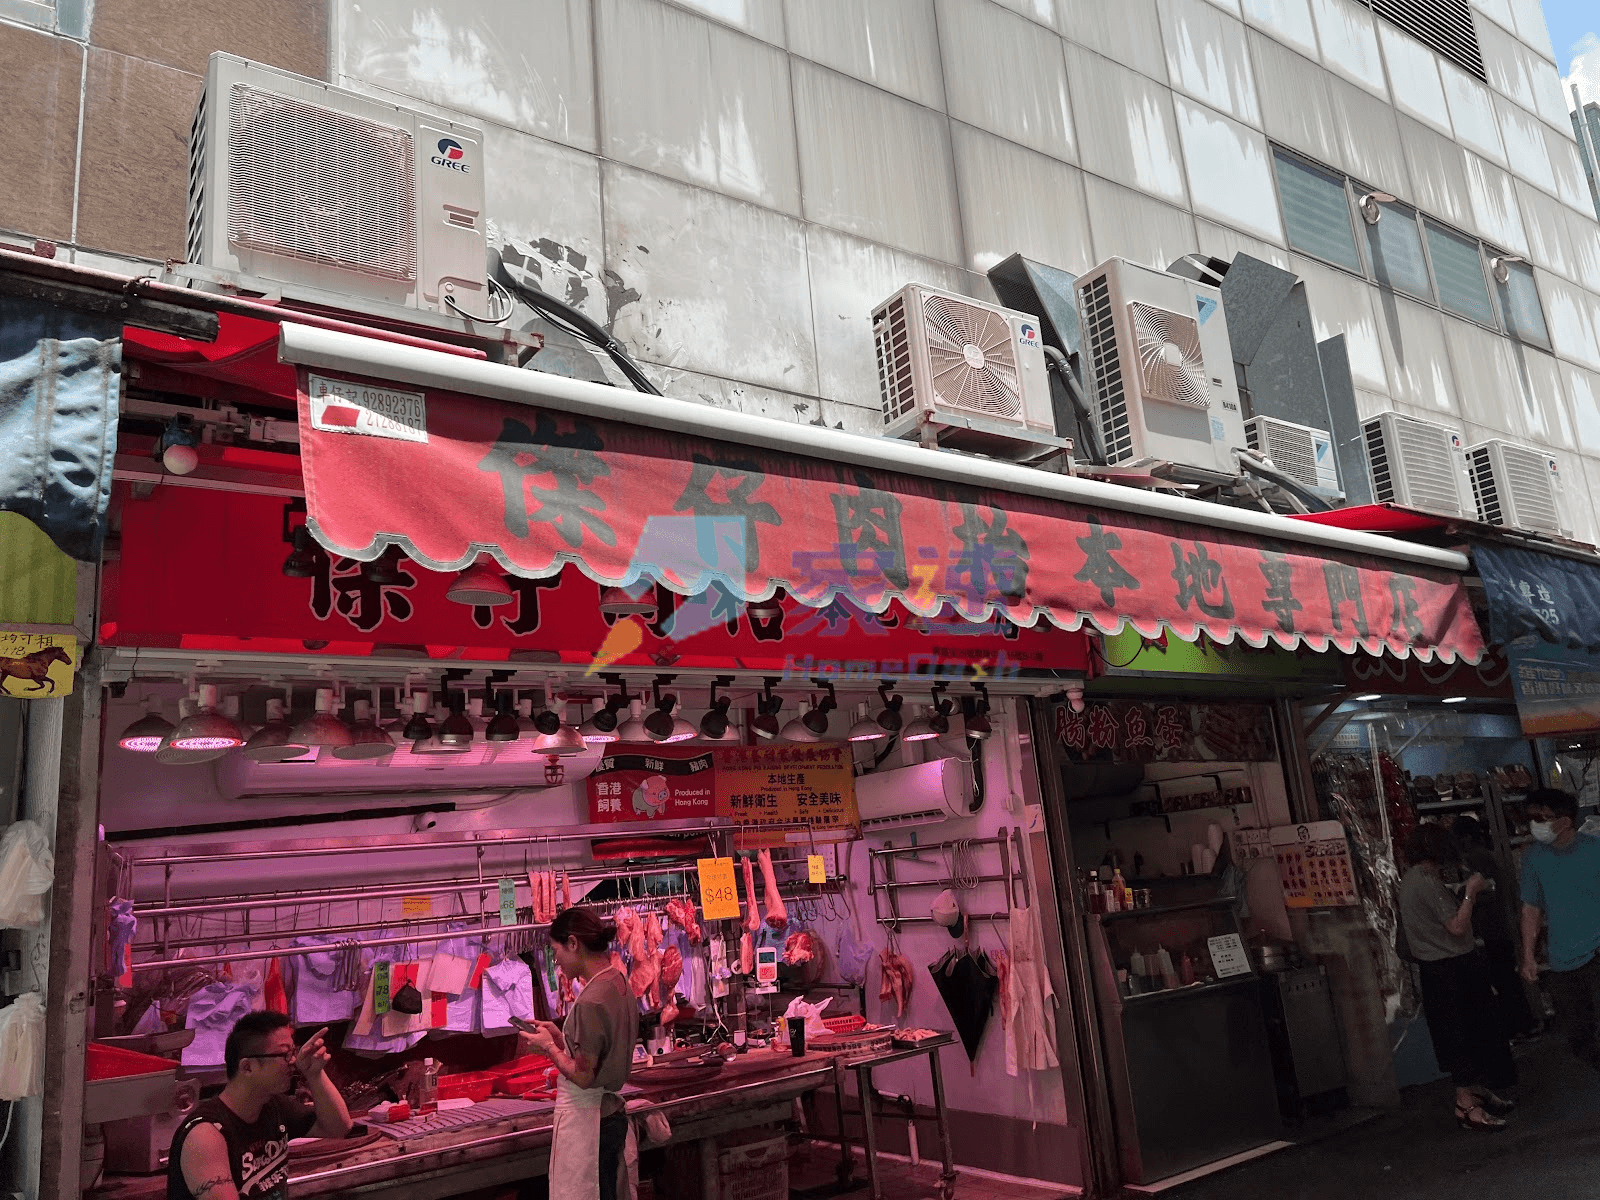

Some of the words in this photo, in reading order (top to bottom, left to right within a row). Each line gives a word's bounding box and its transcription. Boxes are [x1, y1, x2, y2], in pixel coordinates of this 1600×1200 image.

[431, 156, 471, 173] GREE
[317, 381, 357, 404] 車仔記
[362, 391, 421, 418] 92892376
[645, 758, 664, 771] 新鮮
[689, 760, 708, 772] 豬肉
[768, 773, 805, 785] 本地生產
[597, 782, 621, 795] 香港
[675, 788, 703, 796] Produced
[597, 799, 621, 812] 飼養
[693, 798, 708, 806] Kong
[730, 794, 778, 808] 新鮮衛生
[797, 792, 841, 806] 安全美味
[705, 886, 733, 904] $48
